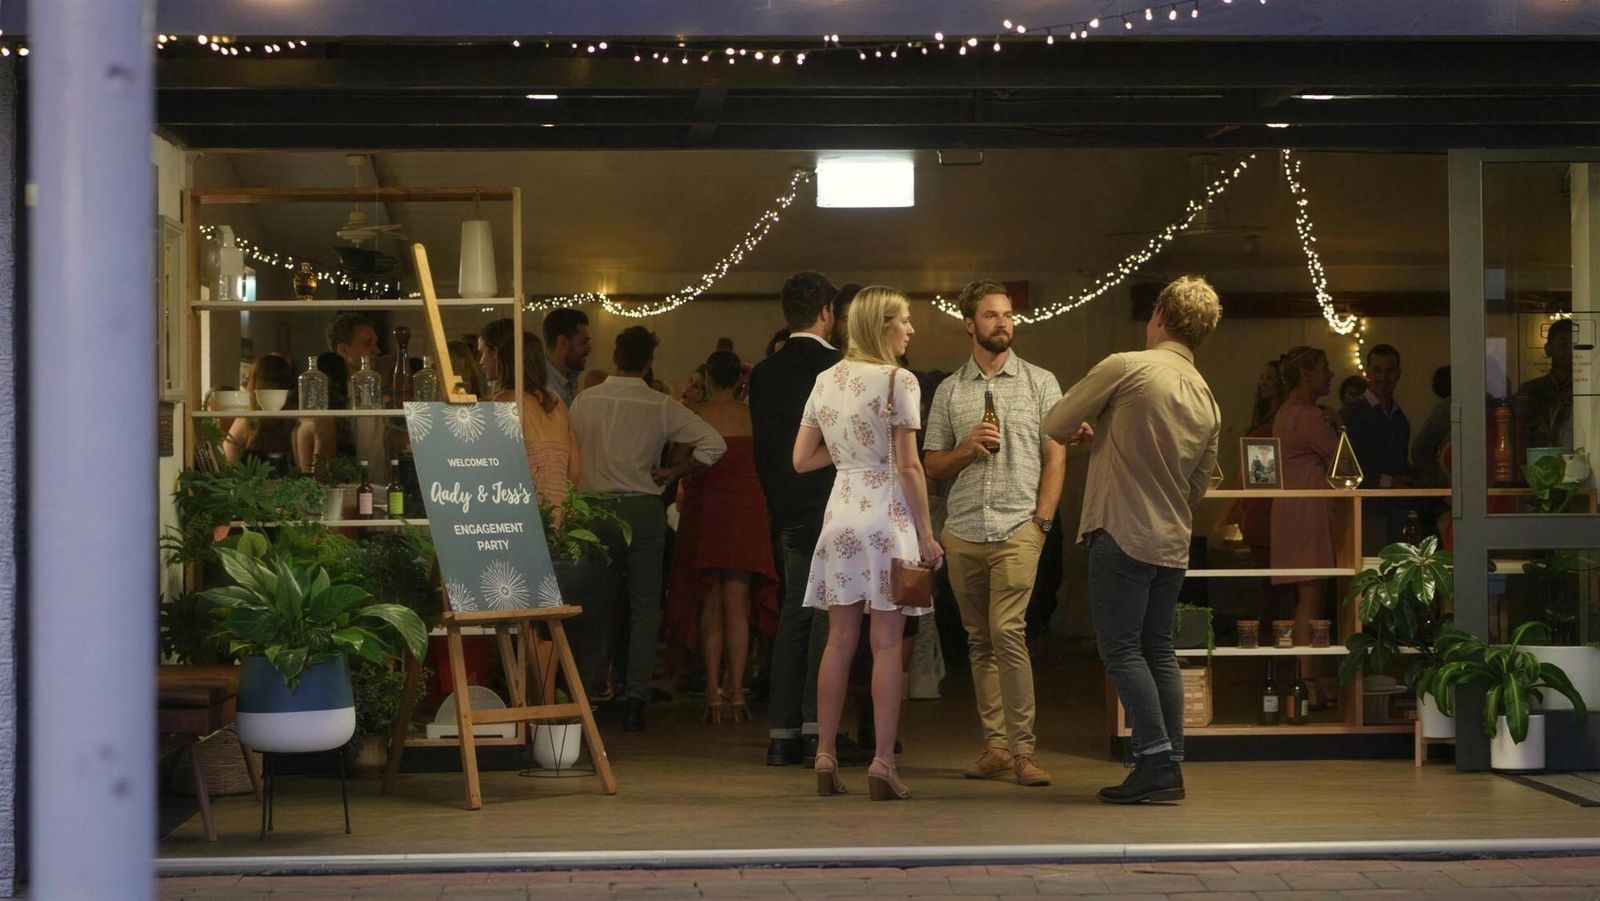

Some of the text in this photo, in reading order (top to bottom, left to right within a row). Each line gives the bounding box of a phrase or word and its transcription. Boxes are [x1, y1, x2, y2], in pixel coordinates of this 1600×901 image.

[447, 458, 500, 467] WELCOME TO
[477, 484, 488, 503] &
[492, 481, 531, 504] Jess's
[454, 523, 523, 535] ENGAGEMENT
[477, 540, 509, 551] PARTY
